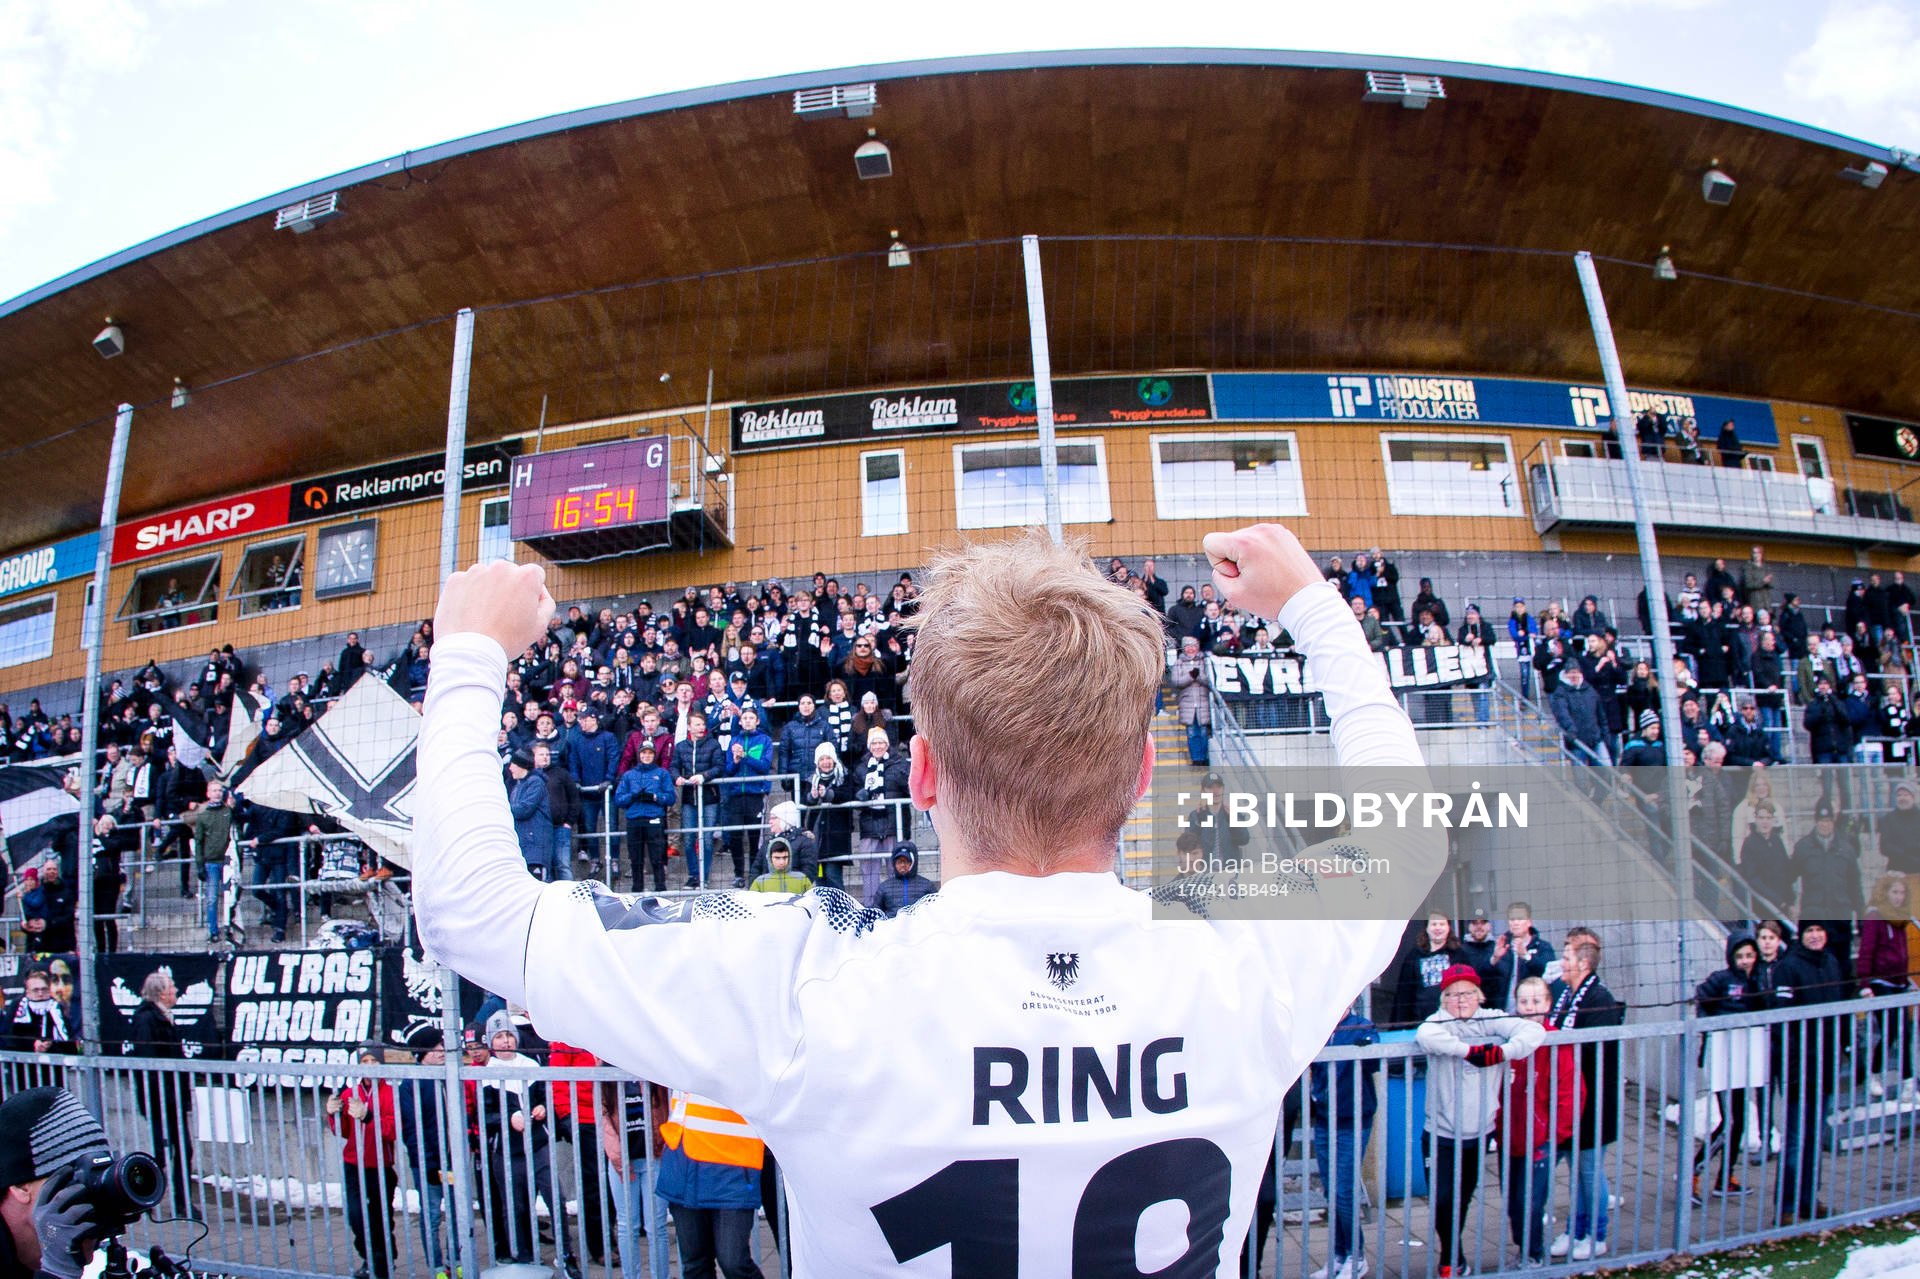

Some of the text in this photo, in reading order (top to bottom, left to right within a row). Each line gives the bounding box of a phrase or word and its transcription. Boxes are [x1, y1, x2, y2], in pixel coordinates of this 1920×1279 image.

[870, 396, 957, 418] Reklam
[1375, 378, 1476, 402] INDUSTRI
[1379, 399, 1480, 420] PRODUKTER
[1625, 391, 1695, 417] DUSTRI
[740, 408, 824, 433] Reklam
[335, 459, 502, 503] Reklamprosen
[516, 443, 663, 488] H G
[136, 503, 255, 550] SHARP
[554, 489, 635, 529] 16:54
[1214, 645, 1489, 695] EYRLLEN
[231, 950, 373, 995] ULTRAS
[232, 999, 371, 1042] NIKOLAI
[1095, 1004, 1117, 1015] 1908
[973, 1037, 1189, 1126] RING
